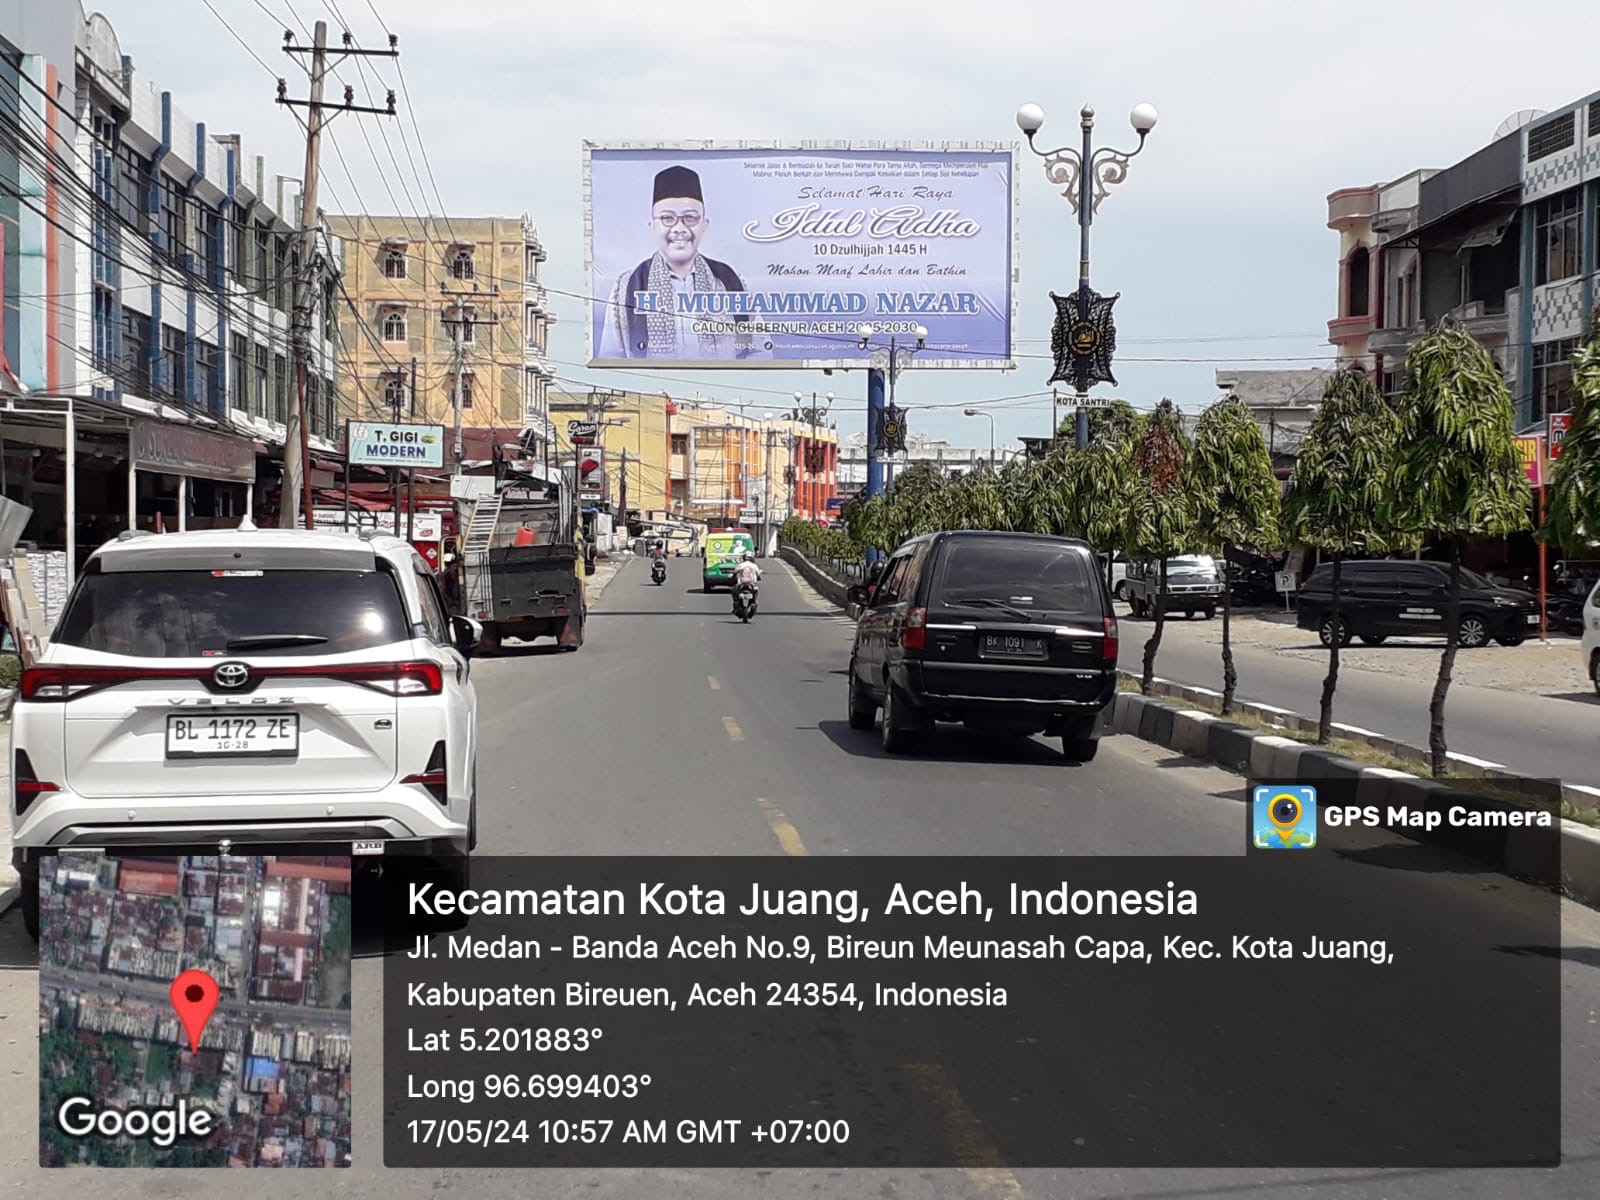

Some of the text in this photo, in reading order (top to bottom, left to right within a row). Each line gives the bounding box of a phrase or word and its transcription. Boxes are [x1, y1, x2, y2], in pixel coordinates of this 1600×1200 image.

[797, 185, 953, 202] Selamat Hari Raya
[743, 202, 982, 243] Idul Adha
[813, 243, 928, 258] 10 Dzulhijjah 1445 H
[767, 263, 967, 279] Mohon Maaf Lahir dan Bathin
[676, 291, 868, 315] MUHAMMAD
[874, 291, 982, 315] NAZAR
[692, 322, 734, 334] CALON
[737, 322, 807, 334] GUBERNUR
[810, 322, 844, 334] ACEH
[1056, 397, 1110, 407] KOTA SANTRI
[374, 430, 418, 444] T. GIGI
[366, 444, 426, 457] MODERN
[175, 718, 290, 740] BL 1172 ZE
